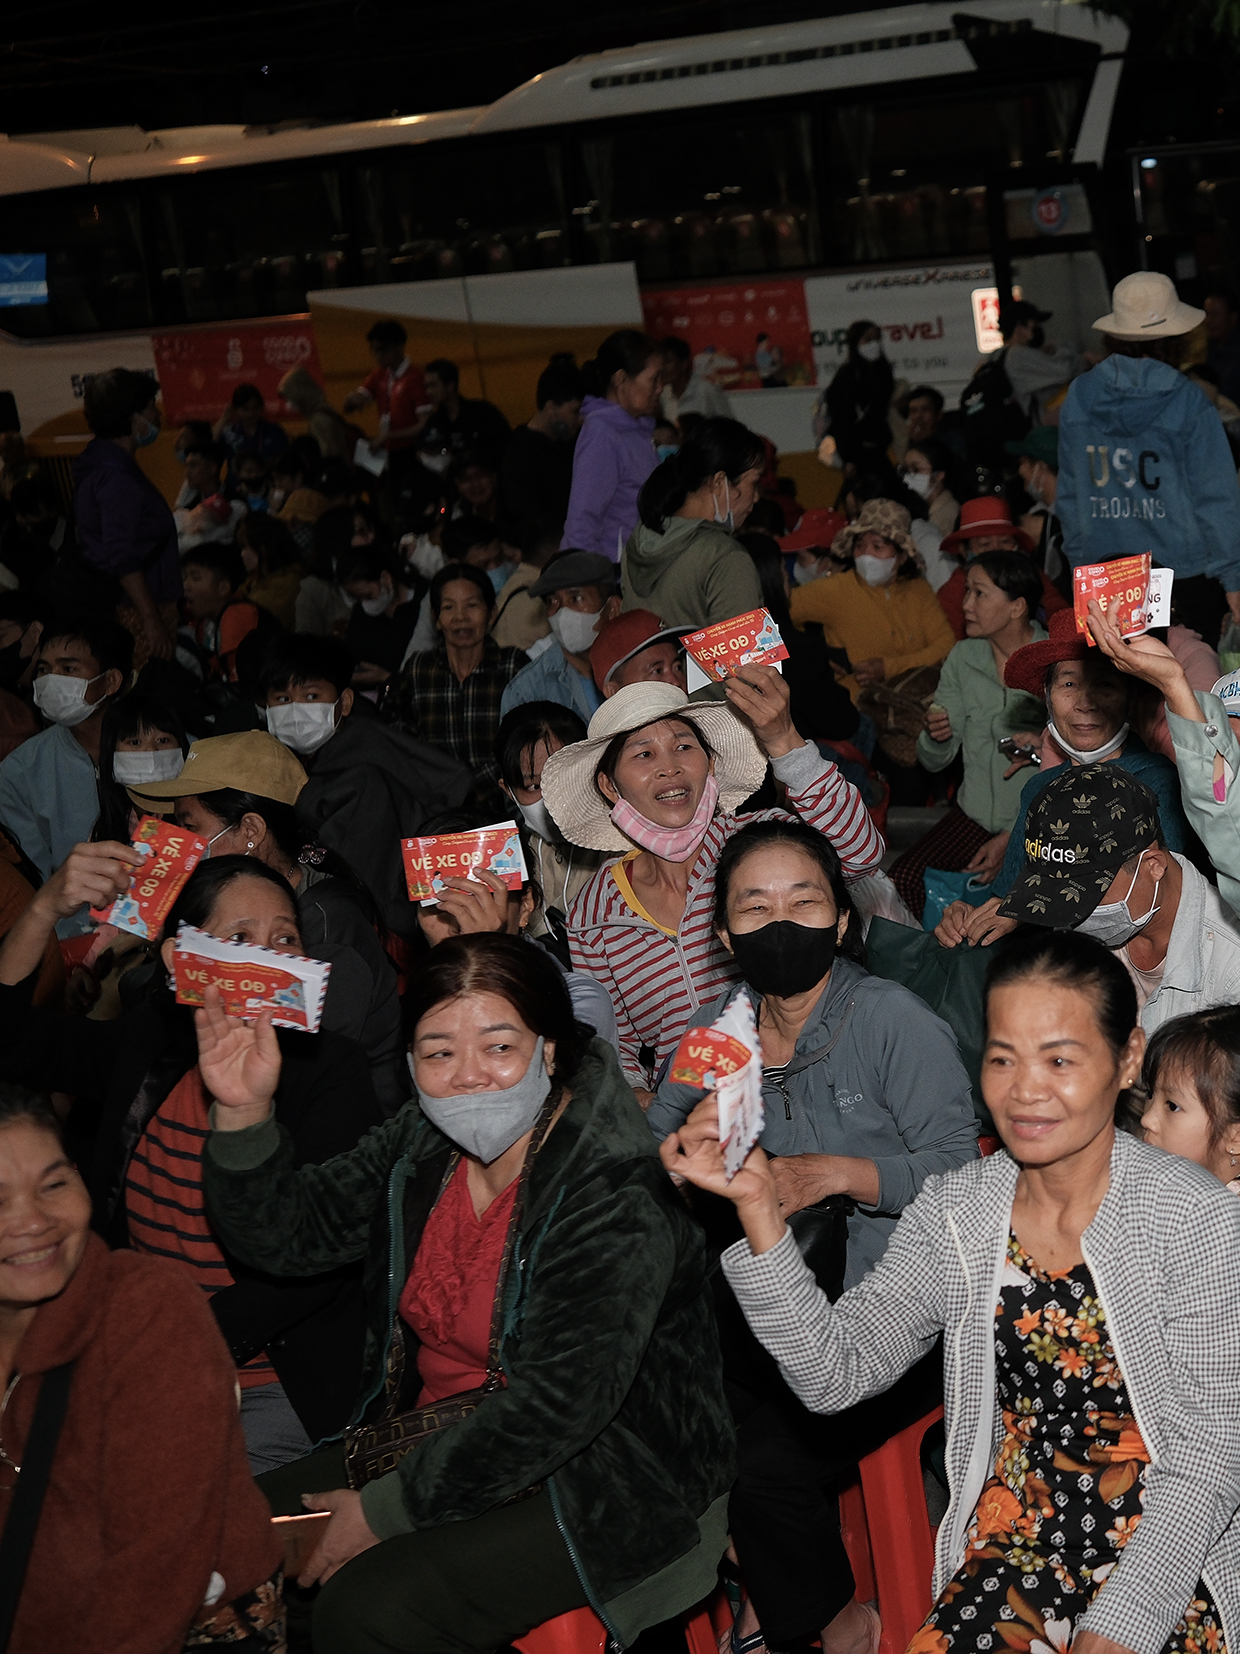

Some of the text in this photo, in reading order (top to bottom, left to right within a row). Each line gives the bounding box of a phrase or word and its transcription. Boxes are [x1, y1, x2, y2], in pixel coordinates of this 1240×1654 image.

[1086, 445, 1160, 490] USC
[1090, 496, 1165, 520] TROJANS
[709, 642, 728, 658] XE
[162, 837, 184, 858] VÉ
[1025, 838, 1076, 864] adidas
[150, 858, 173, 878] XE
[411, 853, 433, 870] VÉ
[436, 854, 457, 868] XE
[184, 968, 209, 984] VÉ
[212, 975, 235, 991] XE
[688, 1045, 714, 1062] VÉ
